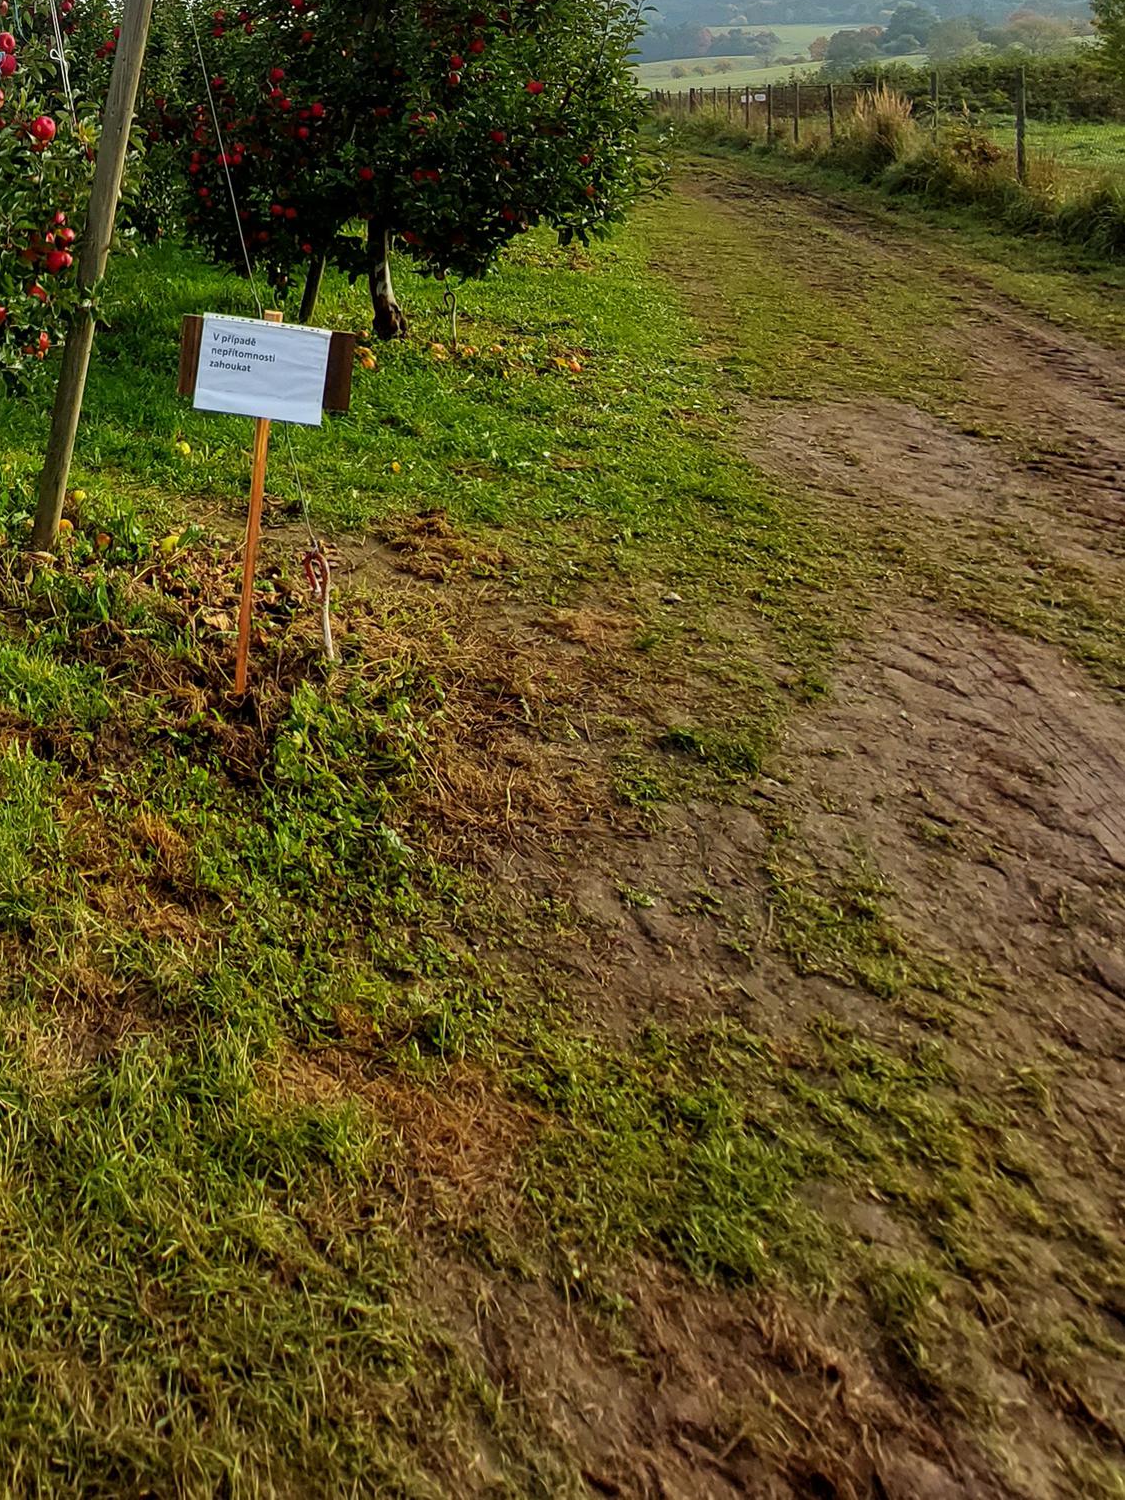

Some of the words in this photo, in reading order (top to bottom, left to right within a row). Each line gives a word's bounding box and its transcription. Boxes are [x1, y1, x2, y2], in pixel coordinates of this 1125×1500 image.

[213, 332, 220, 341] V
[221, 334, 256, 346] případě
[211, 347, 276, 363] nepřítomnosti
[209, 360, 251, 373] zahoukat
